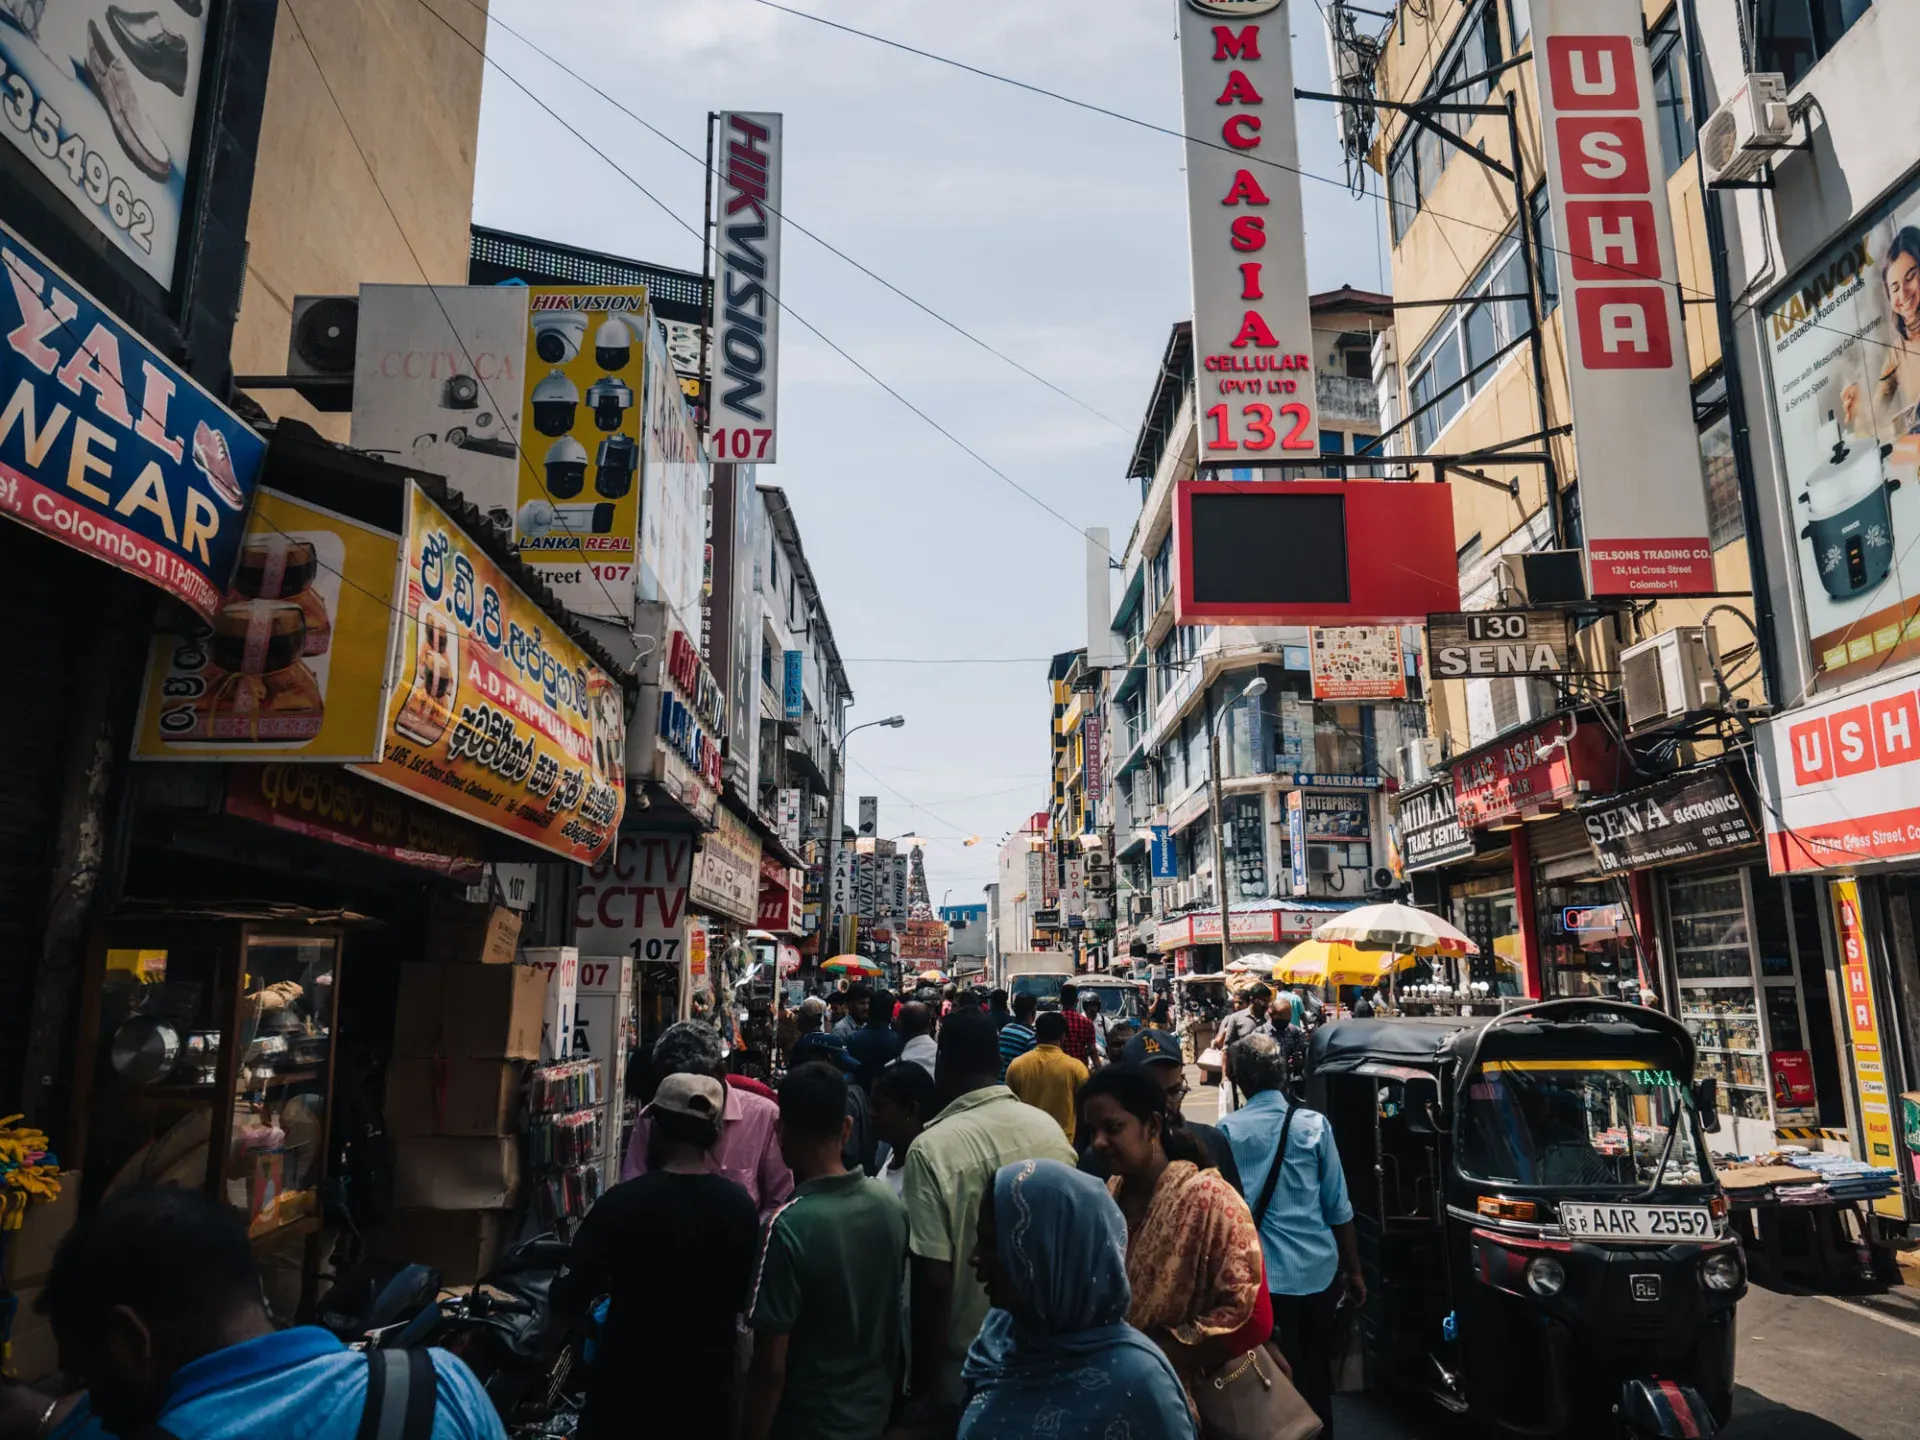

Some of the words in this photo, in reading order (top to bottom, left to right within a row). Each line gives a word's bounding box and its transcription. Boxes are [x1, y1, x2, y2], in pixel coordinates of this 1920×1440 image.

[1569, 50, 1649, 352] USHA
[721, 114, 770, 422] HIKVISION
[1772, 235, 1875, 341] KANVOX
[531, 294, 642, 311] HIKVISION
[1776, 338, 1790, 354] RICE
[1790, 319, 1814, 344] COOKER
[1818, 303, 1836, 320] FOOD
[1835, 278, 1866, 308] STEAMER
[1205, 354, 1309, 372] CELLULAR
[1219, 377, 1263, 394] (PVT)
[1268, 379, 1297, 394] LTD
[1206, 403, 1314, 450] 132
[712, 428, 772, 459] 107
[32, 493, 151, 568] Colombo
[518, 536, 580, 550] LANKA
[584, 536, 632, 550] REAL
[1590, 550, 1641, 560] NELSONS
[1642, 550, 1691, 560] TRADING
[1692, 549, 1712, 559] CO.
[537, 568, 582, 584] treet
[592, 565, 630, 581] 107
[1641, 565, 1666, 575] Cross
[1667, 564, 1692, 574] Street
[1629, 579, 1678, 589] Colombo-11
[1473, 615, 1526, 639] 130
[735, 561, 747, 740] LANKA
[1438, 644, 1562, 676] SENA
[1306, 796, 1363, 811] ENTERPRISES
[1400, 783, 1458, 834] MIDLAN
[1585, 797, 1671, 845] SENA
[1407, 831, 1432, 855] TRADE
[1433, 822, 1466, 847] CENTRE
[508, 876, 525, 900] 107
[1070, 862, 1080, 899] TOPA
[576, 885, 688, 928] CCTV
[1566, 910, 1617, 928] OPN
[1202, 918, 1253, 934] Shaira's
[629, 938, 680, 960] 107
[560, 957, 576, 989] 107
[1841, 902, 1871, 1027] USHA
[1142, 1035, 1160, 1053] LA
[1593, 1208, 1640, 1233] AAR
[1648, 1210, 1708, 1236] 2559
[1636, 1282, 1656, 1296] RE
